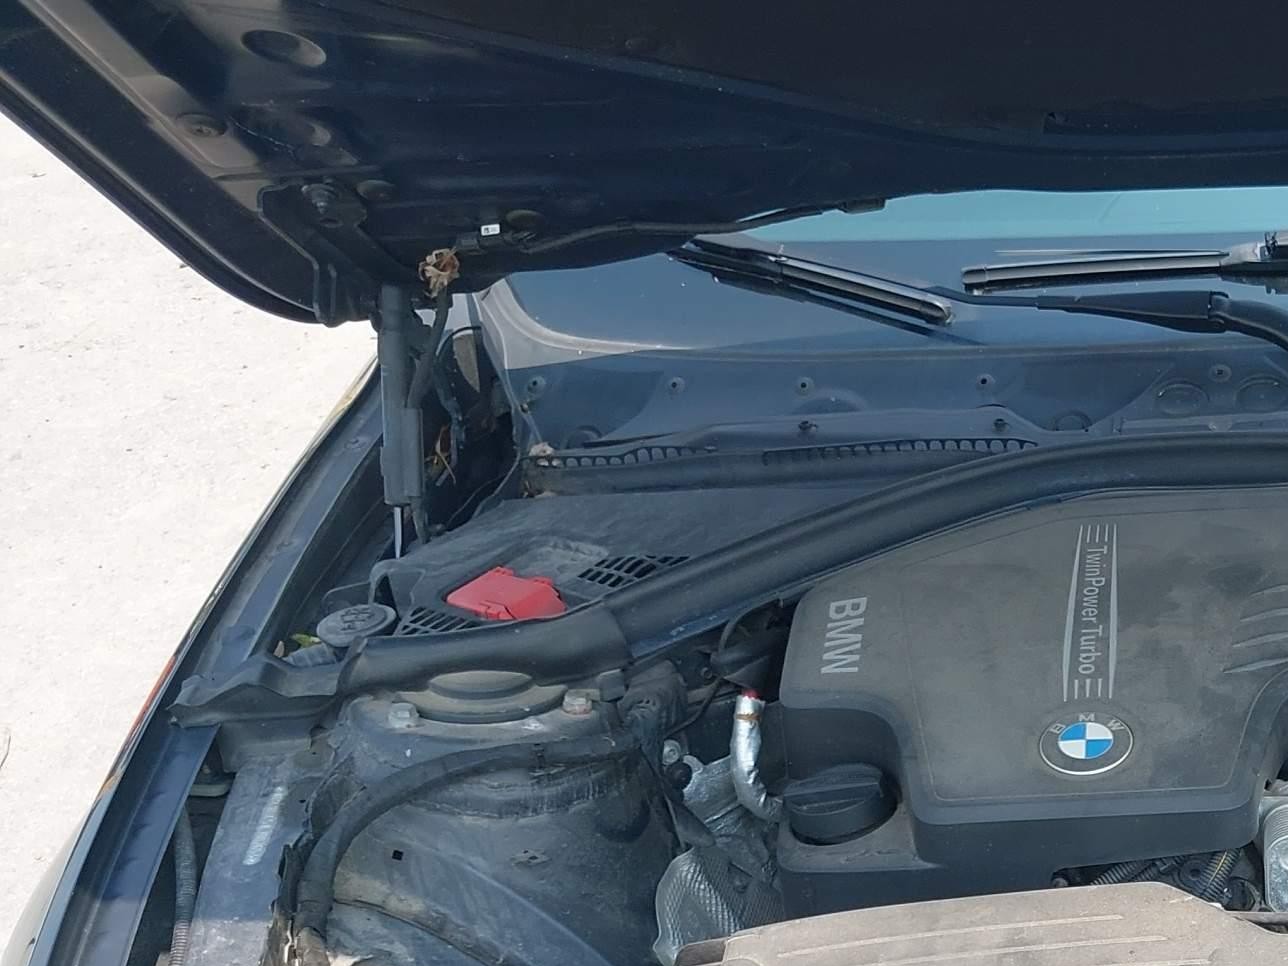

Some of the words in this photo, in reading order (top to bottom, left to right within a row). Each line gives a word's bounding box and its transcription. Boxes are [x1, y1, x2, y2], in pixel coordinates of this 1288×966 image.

[1081, 546, 1107, 624] TwinPower
[821, 597, 868, 674] BMW
[1078, 625, 1103, 674] Turbo
[1049, 712, 1125, 734] BMW
